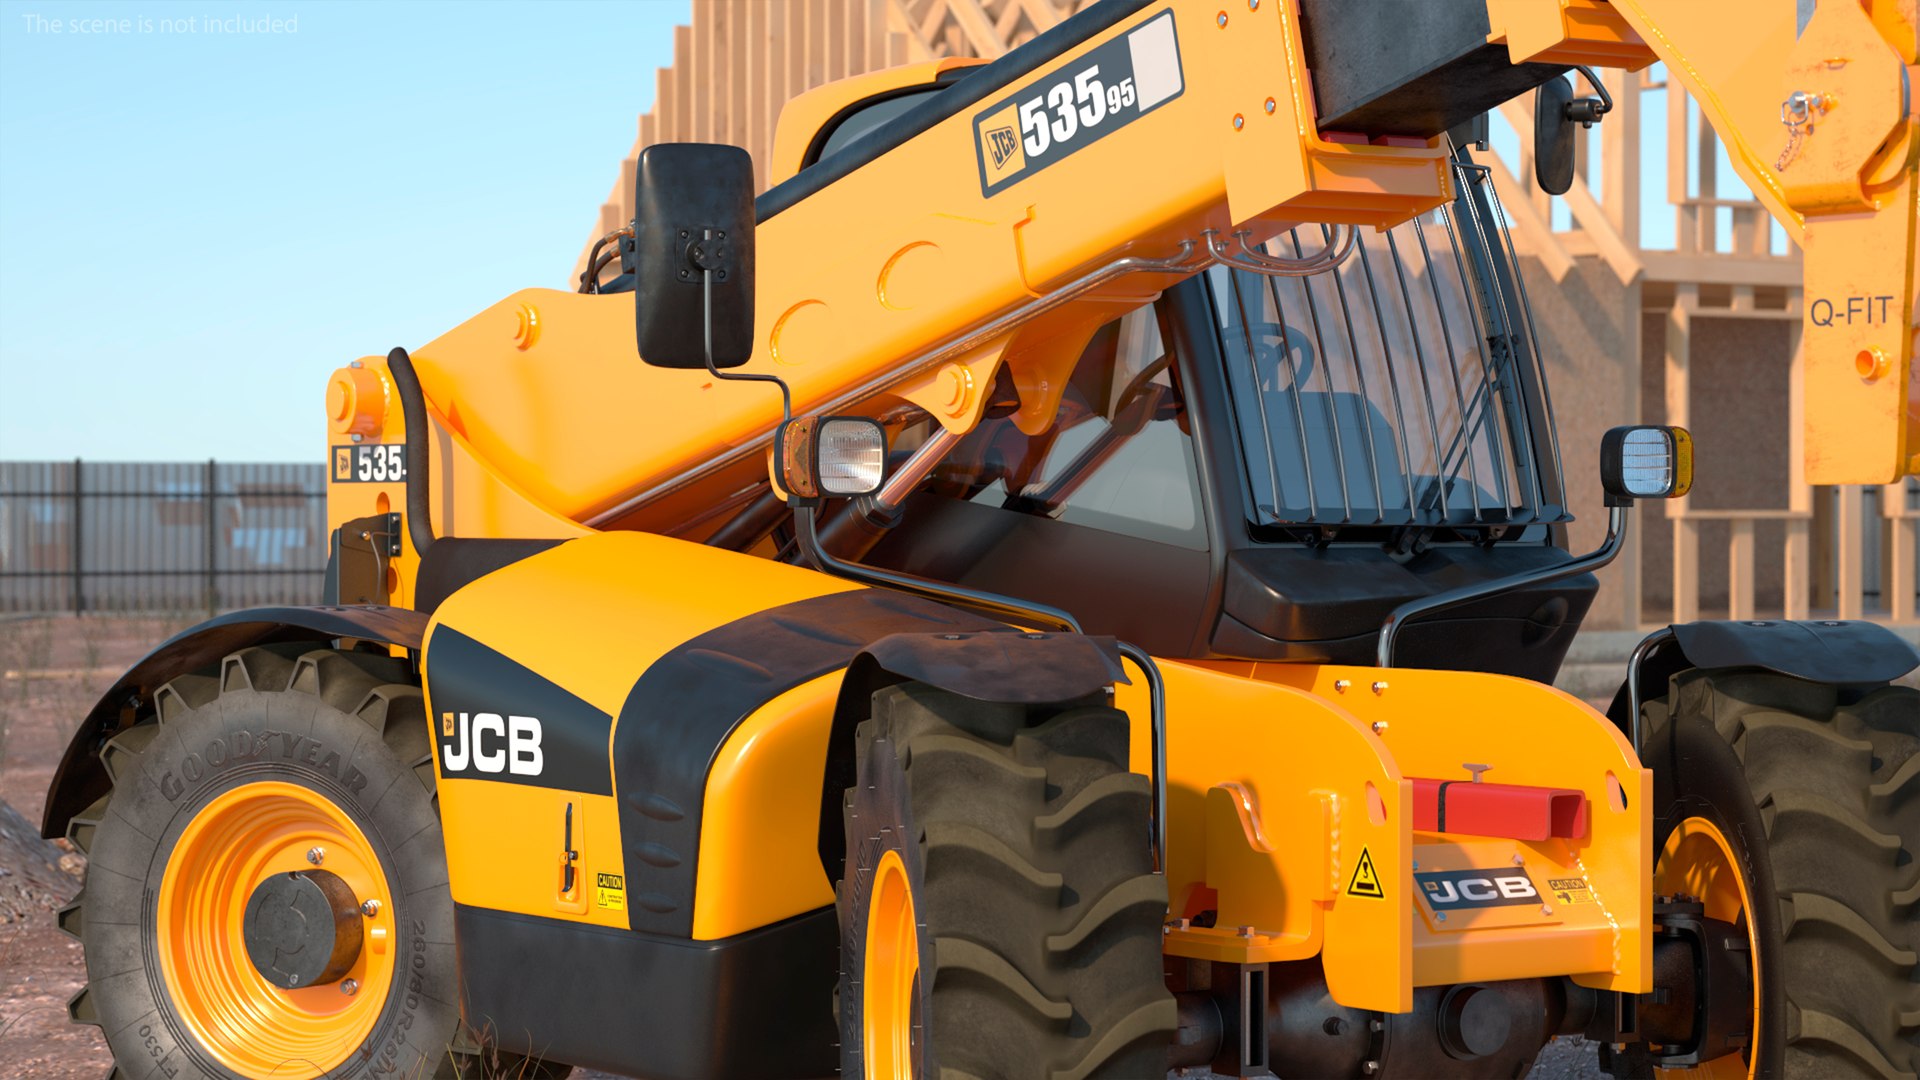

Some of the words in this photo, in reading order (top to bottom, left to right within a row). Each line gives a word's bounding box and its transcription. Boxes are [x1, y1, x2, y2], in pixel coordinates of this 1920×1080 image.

[990, 129, 1016, 165] JCB
[1019, 64, 1107, 157] 535
[1106, 76, 1136, 115] 95
[1811, 295, 1894, 328] Q-FIT
[443, 712, 544, 776] JCB
[160, 728, 369, 802] GOODYEAR
[598, 874, 622, 889] CAUTION
[1429, 876, 1537, 903] JCB
[1550, 880, 1585, 889] CAUTION
